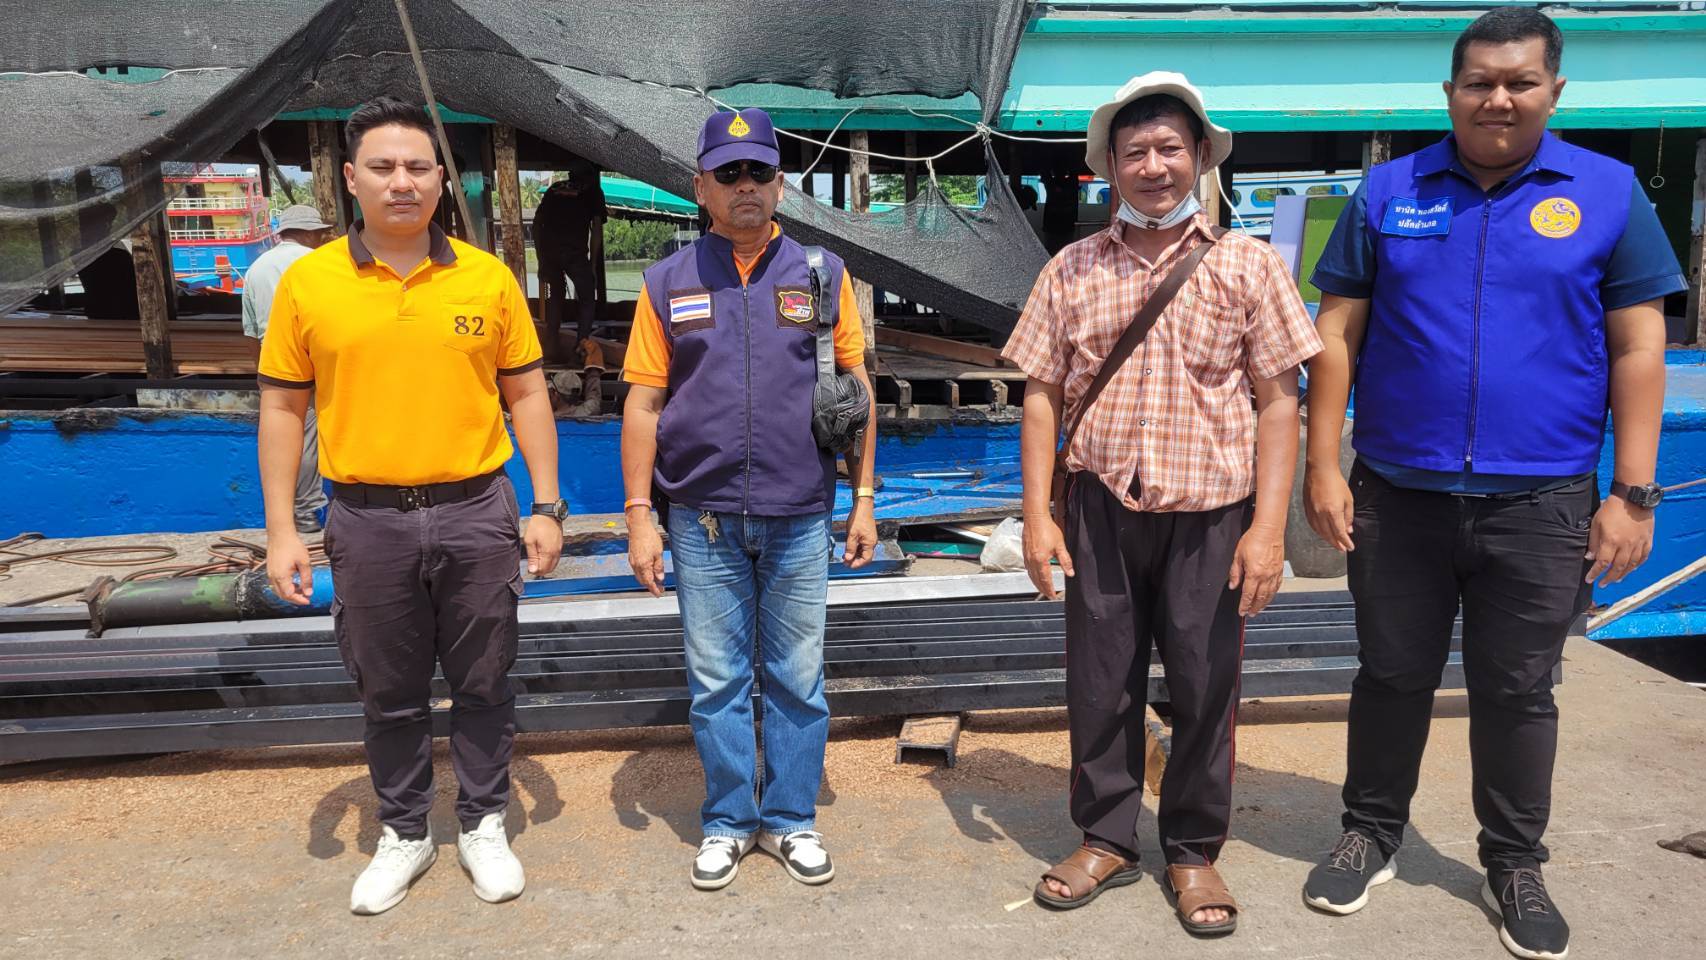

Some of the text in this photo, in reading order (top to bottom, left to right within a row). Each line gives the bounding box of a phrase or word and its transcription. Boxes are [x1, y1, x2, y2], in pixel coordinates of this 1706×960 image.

[1397, 218, 1437, 229] ปลัดอำเภอ
[454, 315, 485, 336] 82
